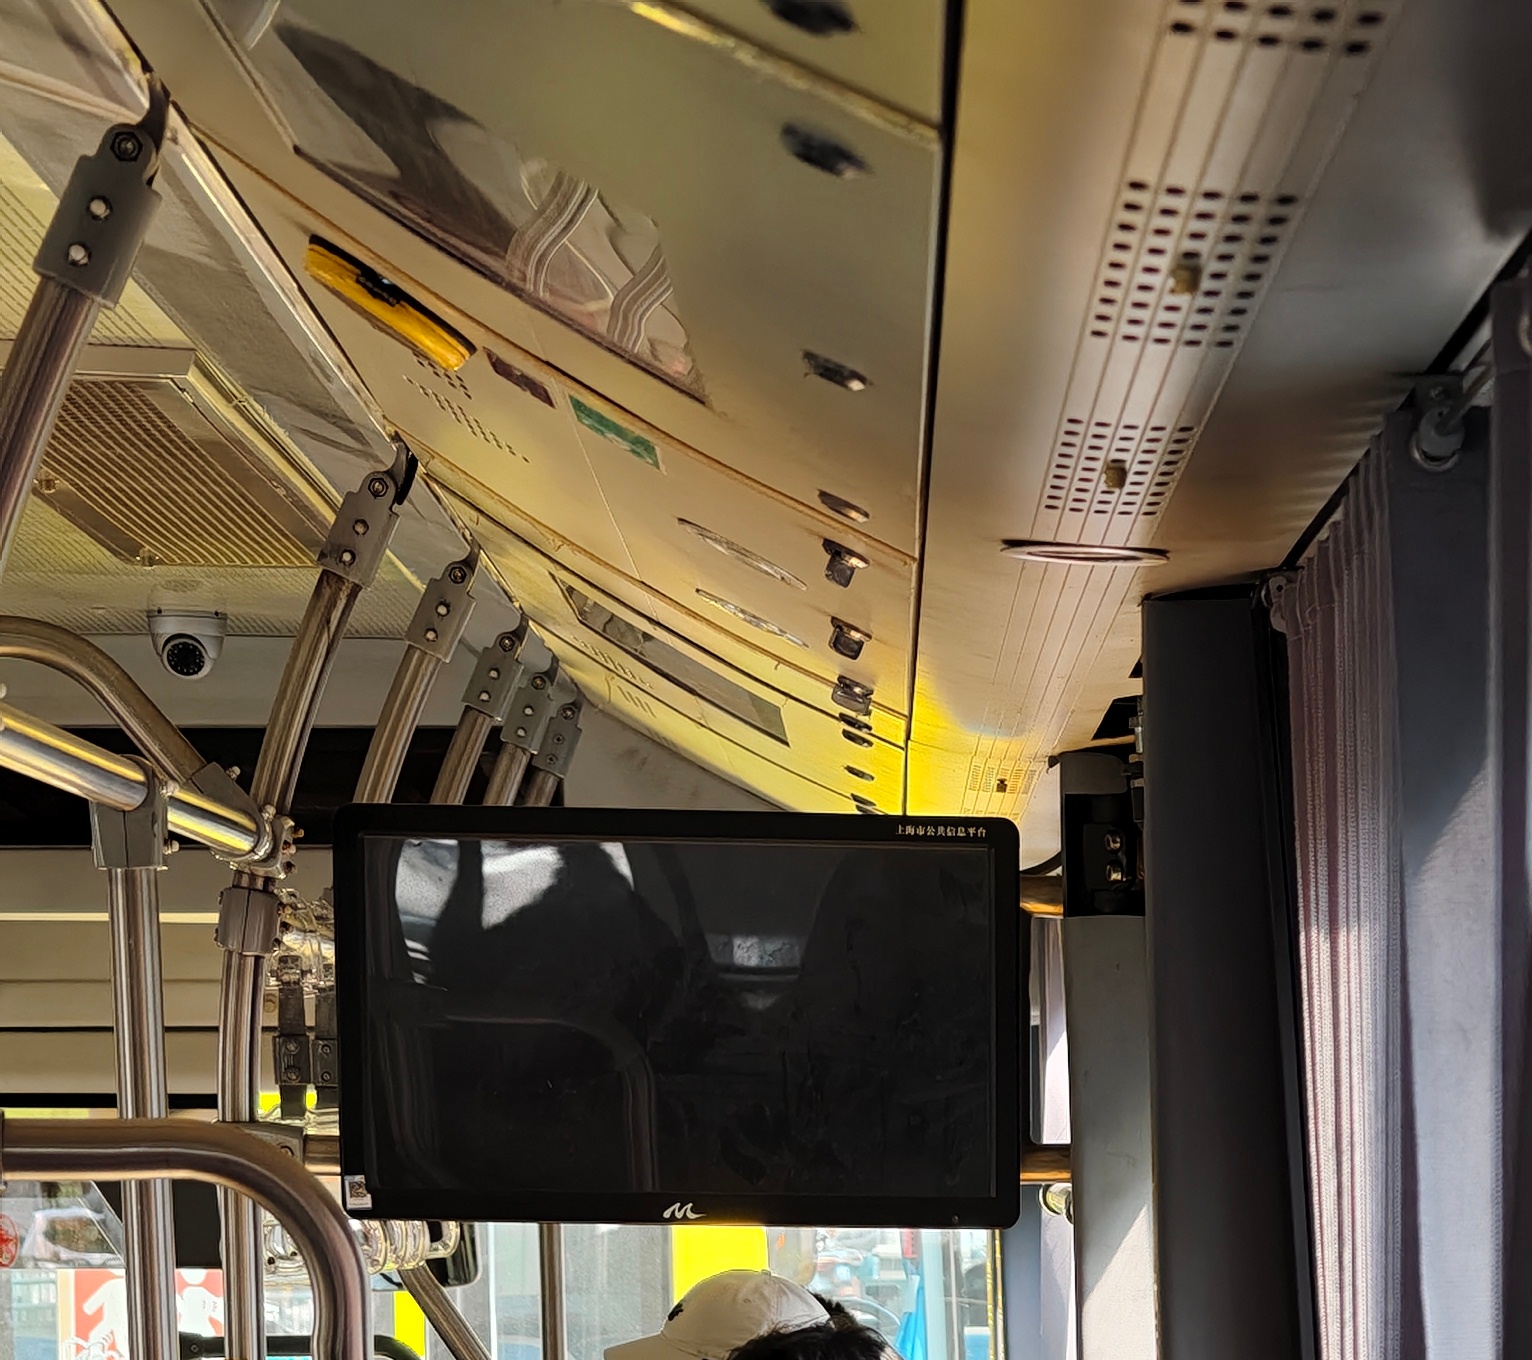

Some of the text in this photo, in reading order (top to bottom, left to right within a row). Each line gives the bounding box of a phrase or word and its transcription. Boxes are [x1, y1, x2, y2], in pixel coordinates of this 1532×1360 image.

[896, 824, 986, 838] 上海市公共信息平台
